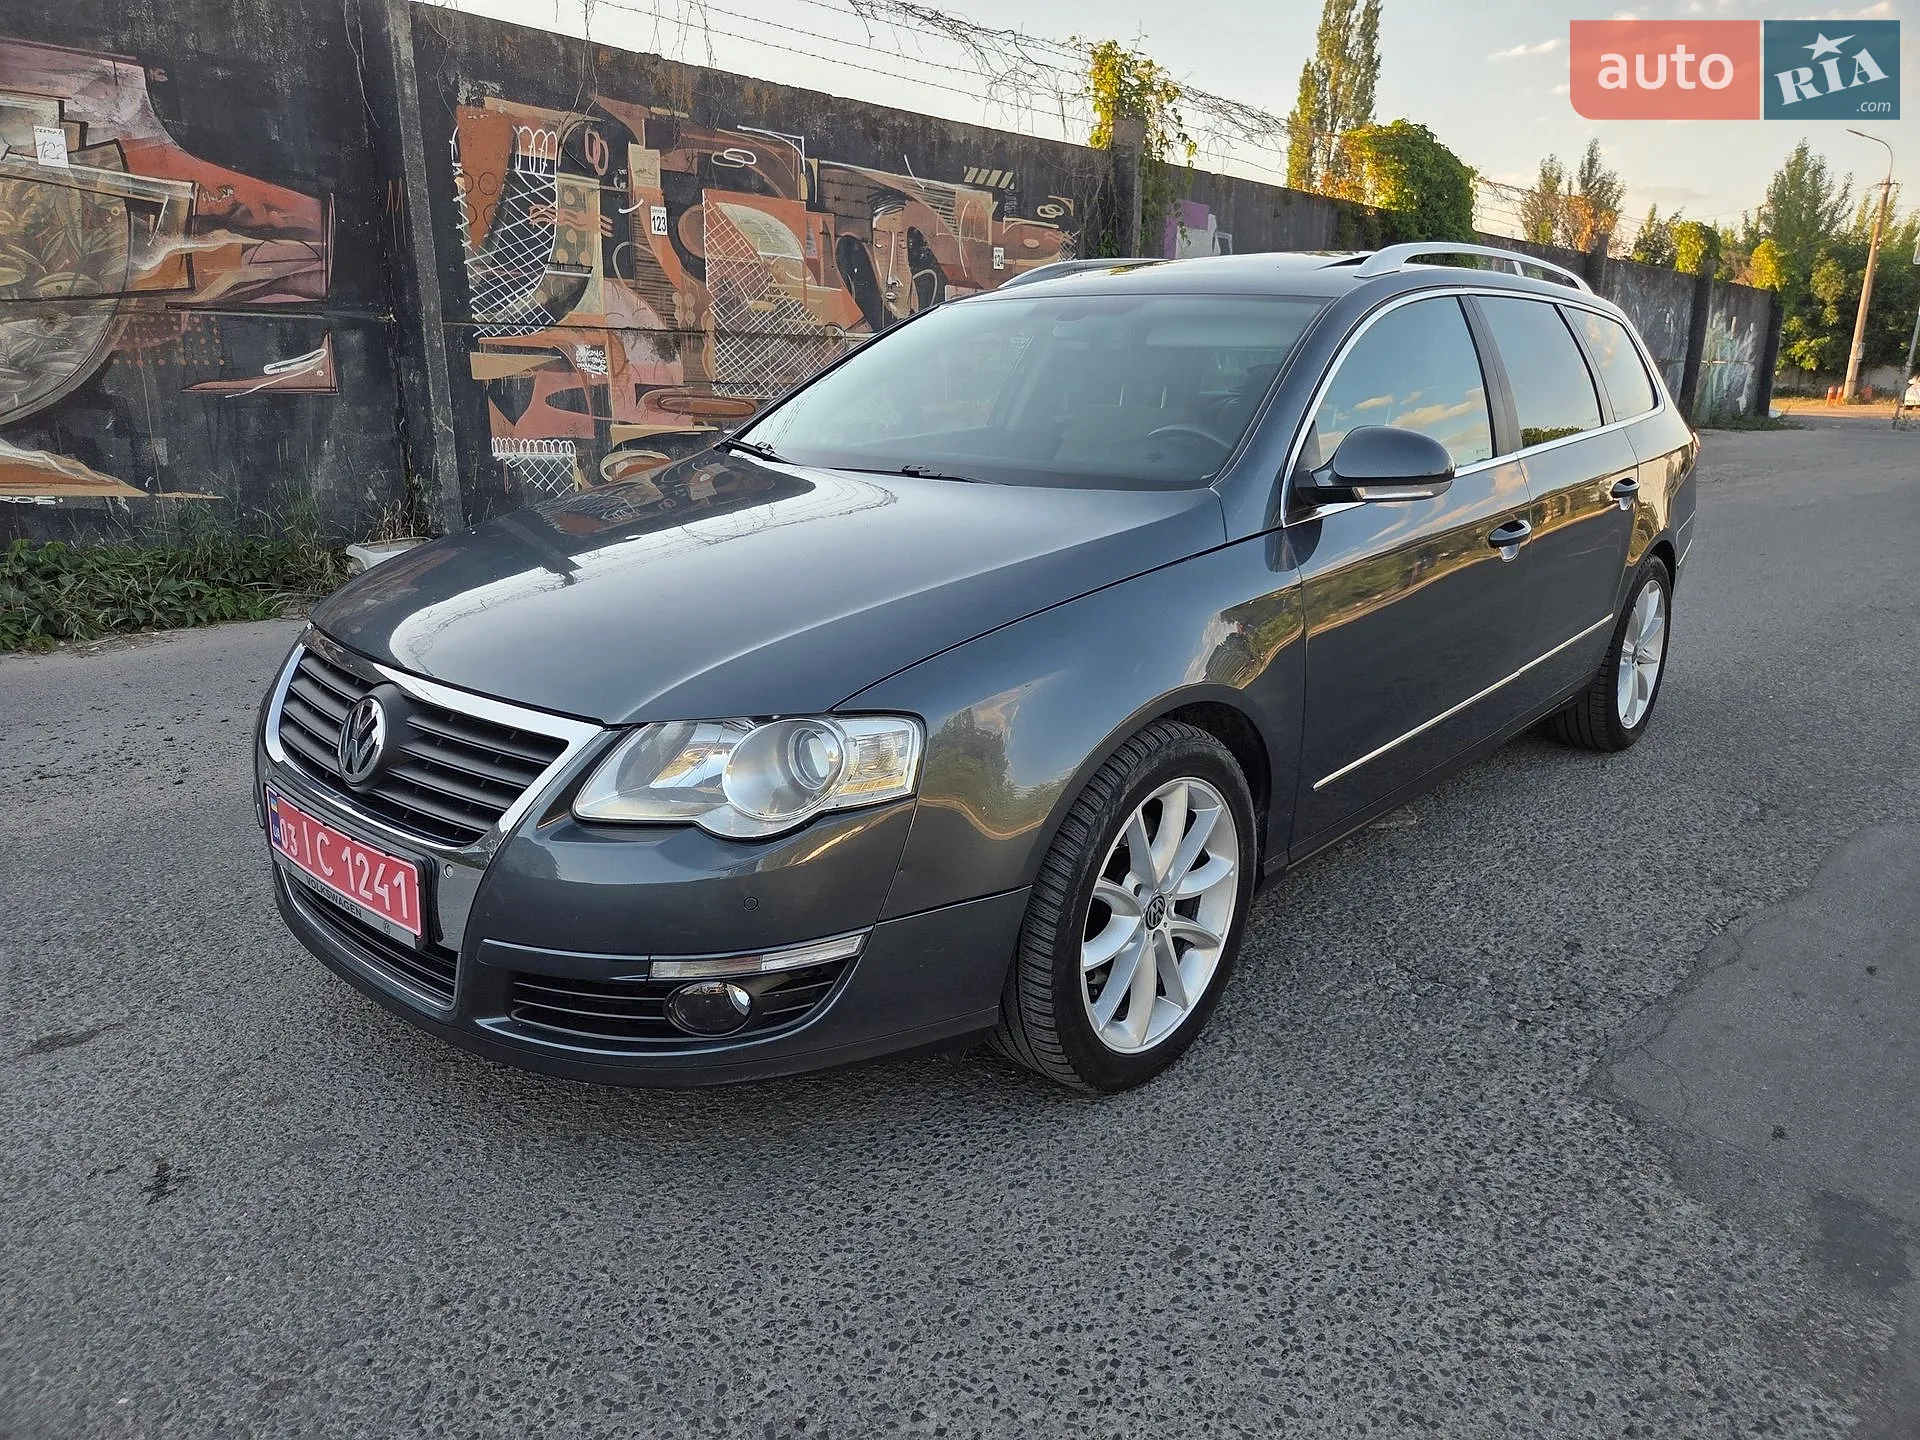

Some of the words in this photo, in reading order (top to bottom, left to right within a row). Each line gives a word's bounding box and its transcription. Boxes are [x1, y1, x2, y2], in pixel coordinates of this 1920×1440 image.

[651, 215, 667, 232] 123
[280, 818, 298, 857] 03
[341, 846, 409, 920] 1241
[304, 875, 363, 918] VOLKSWAGEN
